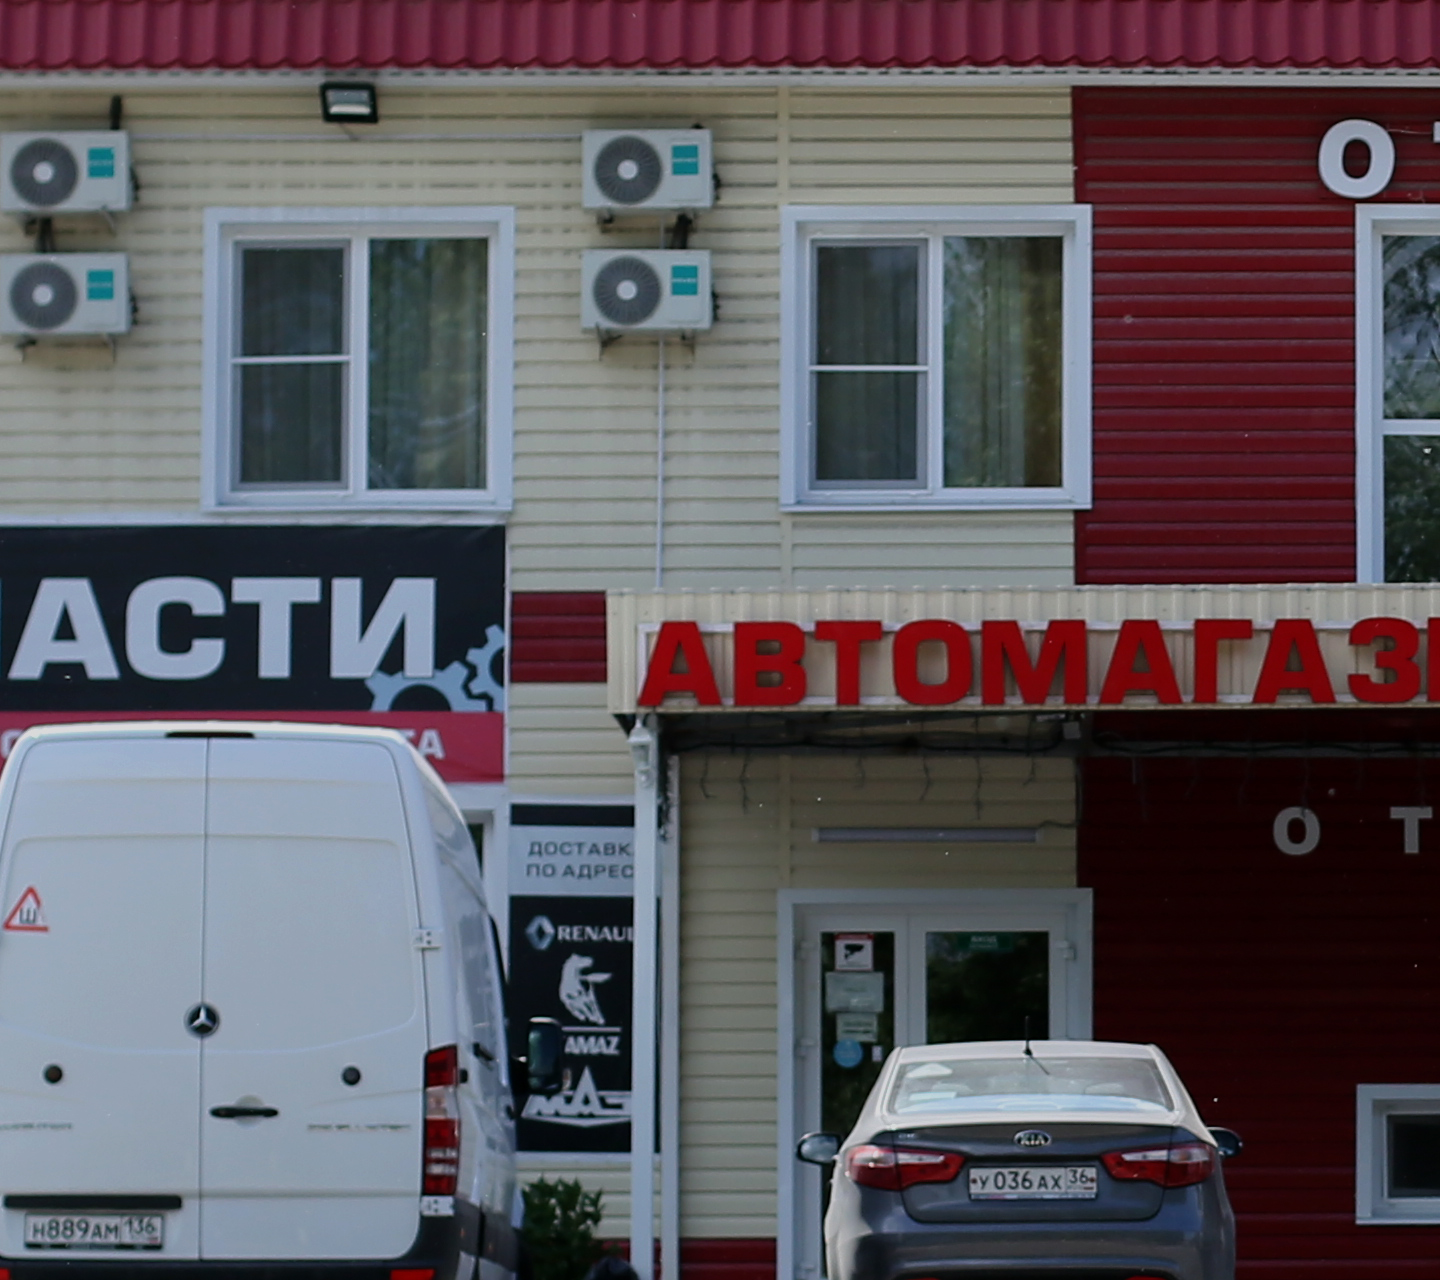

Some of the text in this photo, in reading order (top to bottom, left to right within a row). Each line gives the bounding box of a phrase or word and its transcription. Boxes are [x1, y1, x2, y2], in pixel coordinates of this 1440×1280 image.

[528, 841, 634, 857] ДОСТАВК
[526, 863, 634, 880] ПО АДРЕС
[19, 907, 37, 924] Ш
[563, 1035, 620, 1055] AMAZ
[1019, 1132, 1047, 1147] KIA
[122, 1216, 156, 1235] 136
